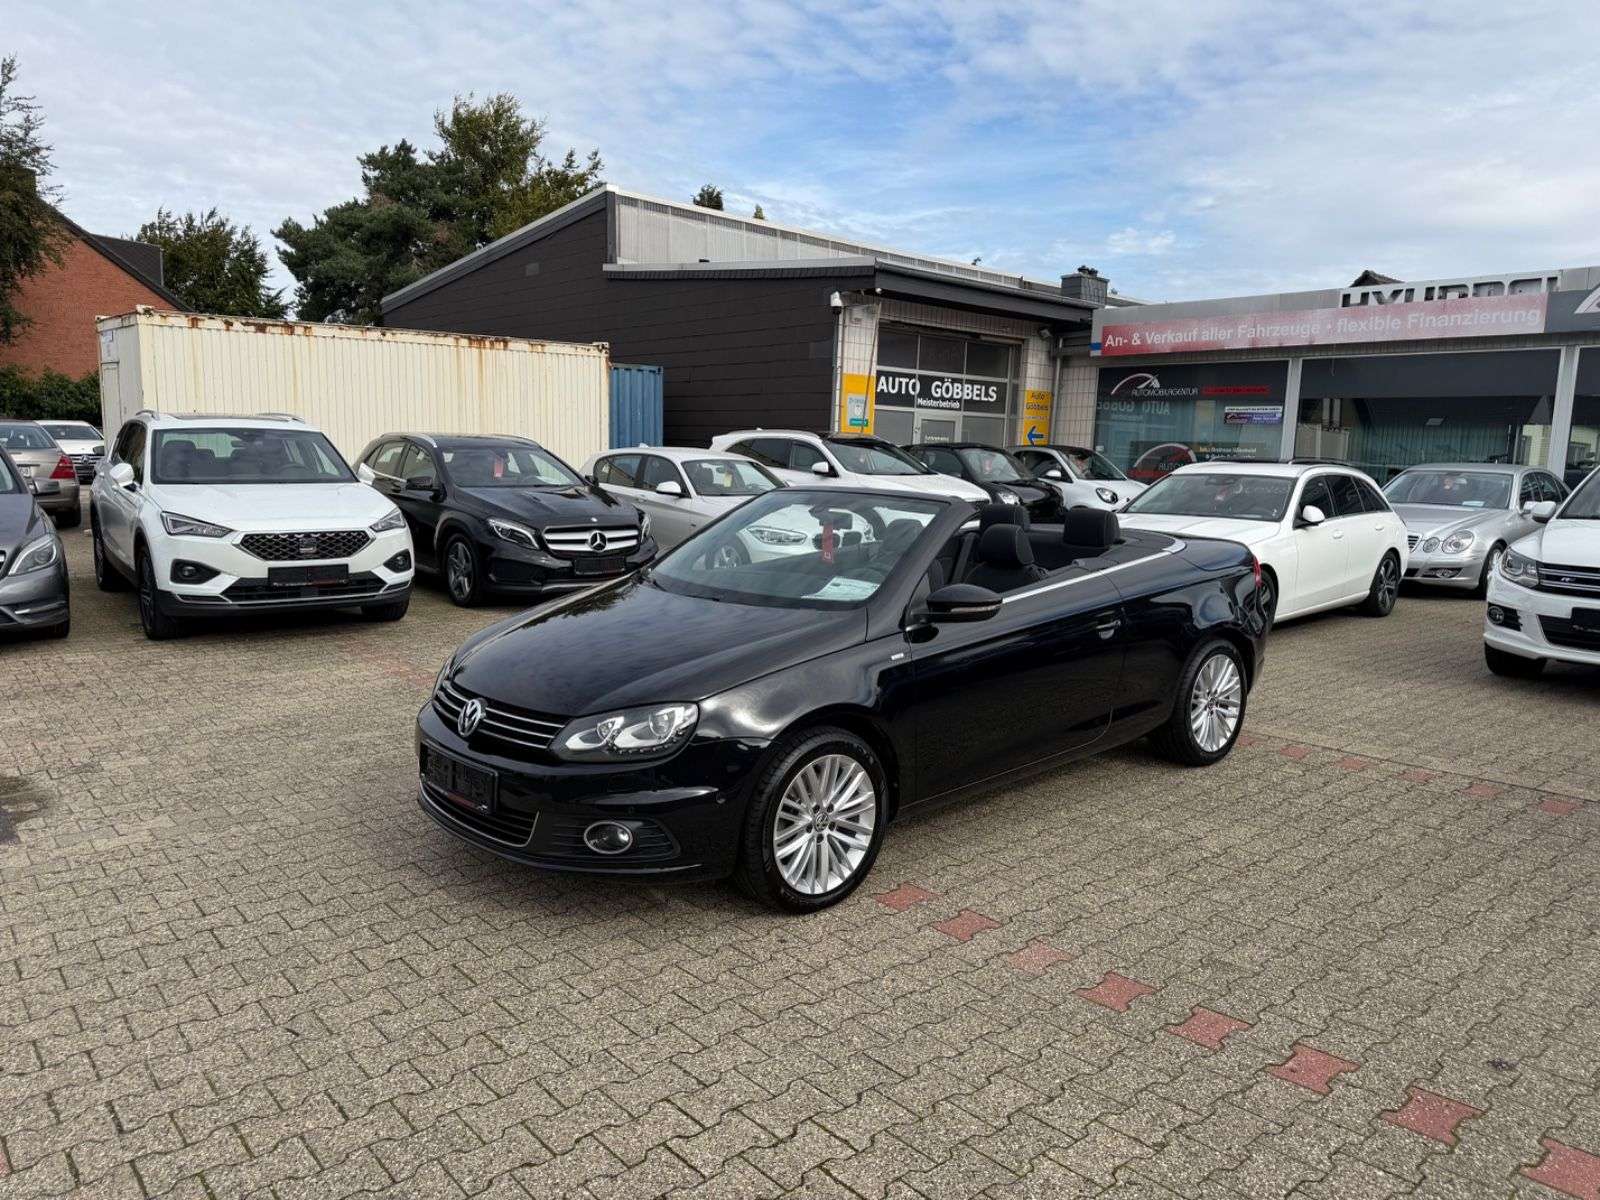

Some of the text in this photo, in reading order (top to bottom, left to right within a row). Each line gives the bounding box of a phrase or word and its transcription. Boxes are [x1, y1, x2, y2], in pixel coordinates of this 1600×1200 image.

[1105, 308, 1541, 347] An- & Verkauf aller Fahrzeuge flexible Finanzierung
[877, 376, 997, 402] AUTO GÖBBELS
[917, 397, 960, 409] Meisterbetrieb
